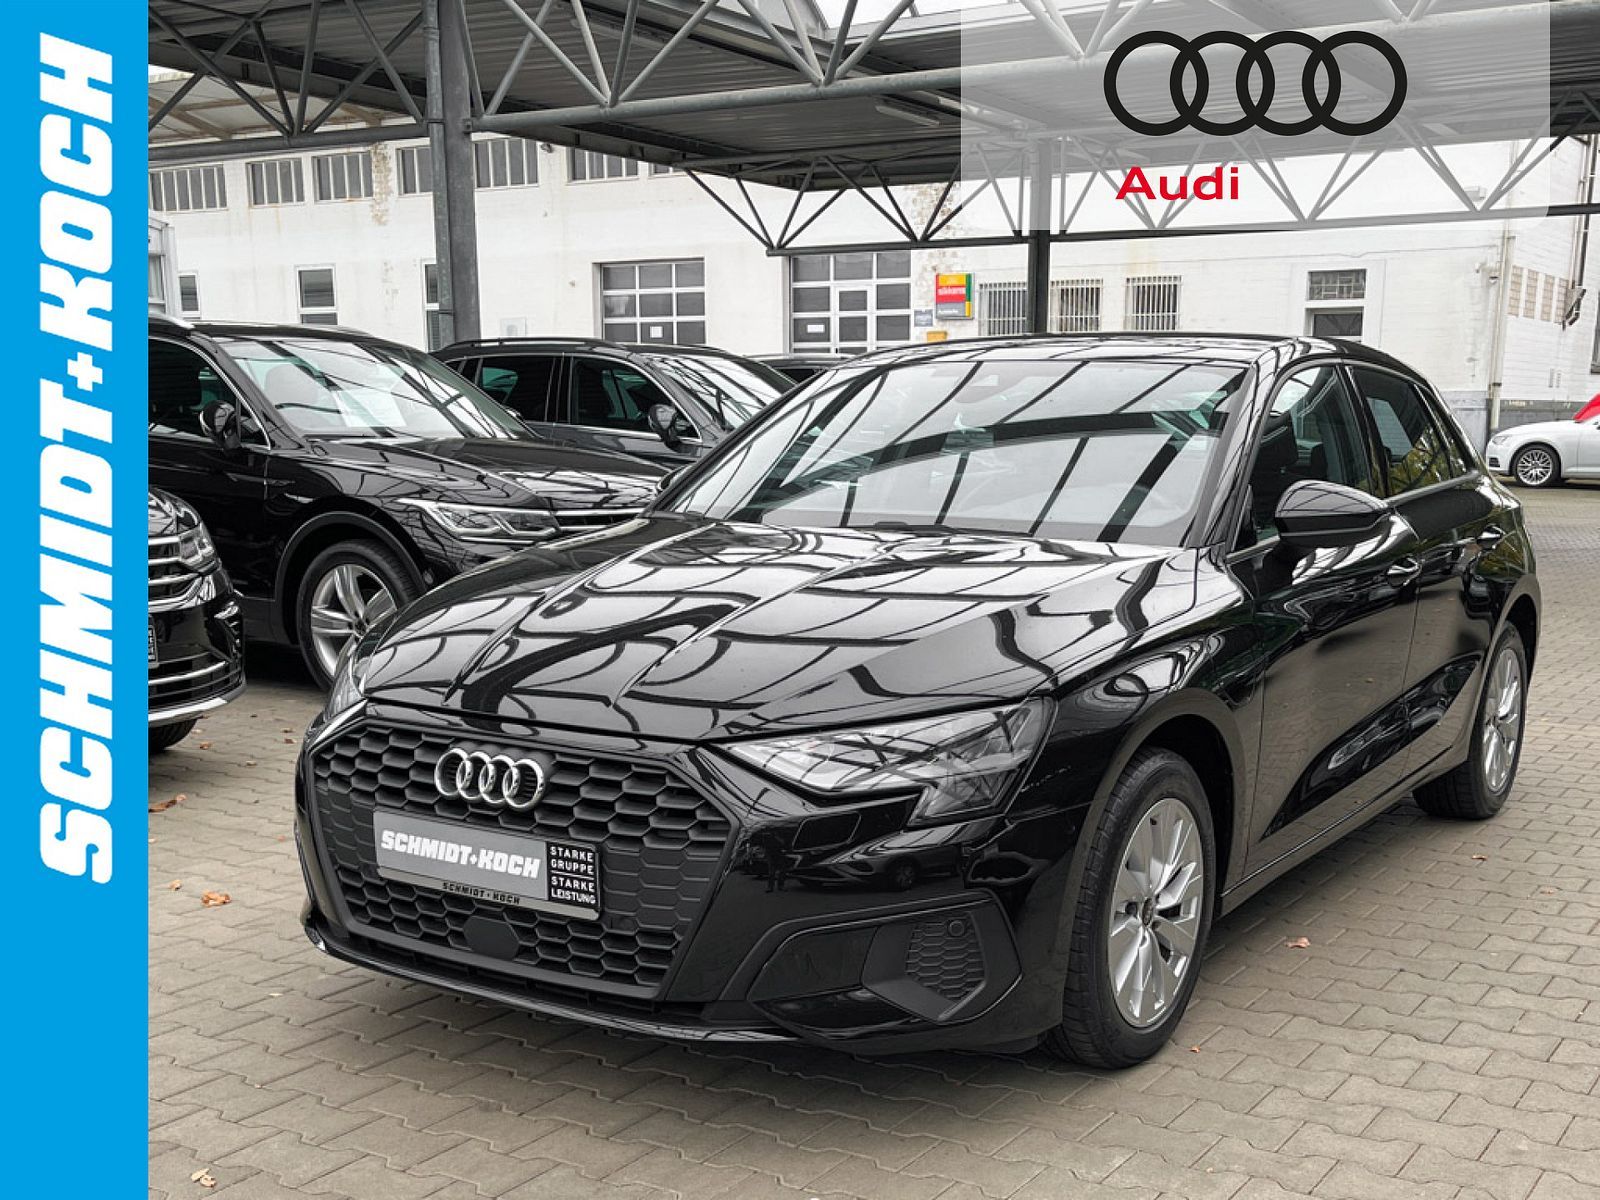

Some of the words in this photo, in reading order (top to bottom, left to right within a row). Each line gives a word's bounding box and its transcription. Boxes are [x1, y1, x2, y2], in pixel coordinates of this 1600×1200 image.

[550, 846, 594, 862] STARKE
[551, 858, 594, 876] GRUPPE
[551, 876, 595, 893] STARKE
[551, 888, 596, 905] LEISTUNG
